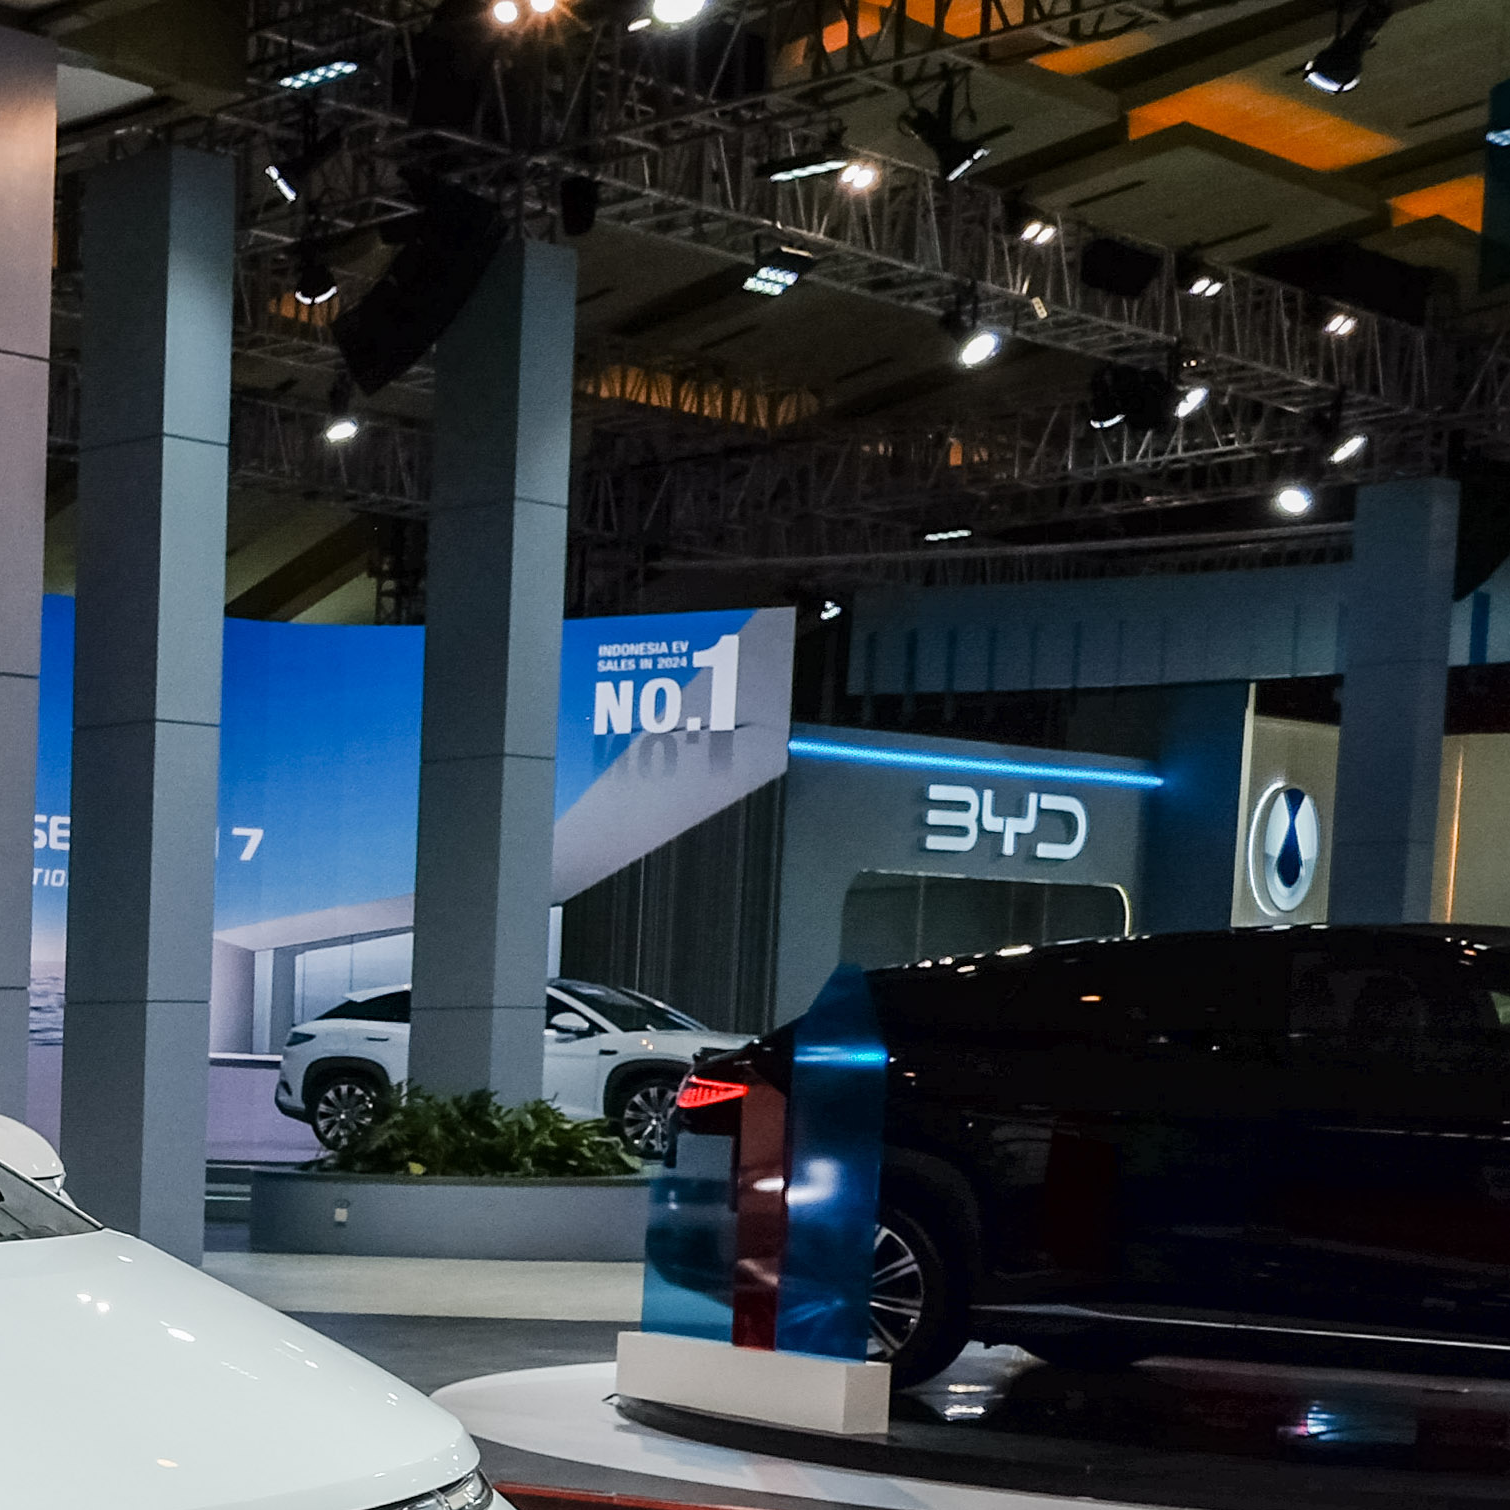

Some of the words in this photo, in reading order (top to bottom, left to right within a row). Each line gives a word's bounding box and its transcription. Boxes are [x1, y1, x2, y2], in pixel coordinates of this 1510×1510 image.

[598, 642, 669, 658] INDONESIA
[671, 641, 689, 653] EV
[597, 658, 636, 672] SALES
[639, 658, 653, 670] IN
[657, 657, 688, 670] 2024
[594, 634, 740, 735] NO.1
[924, 784, 1089, 861] BYD
[231, 827, 264, 861] 7
[32, 867, 68, 888] TIO
